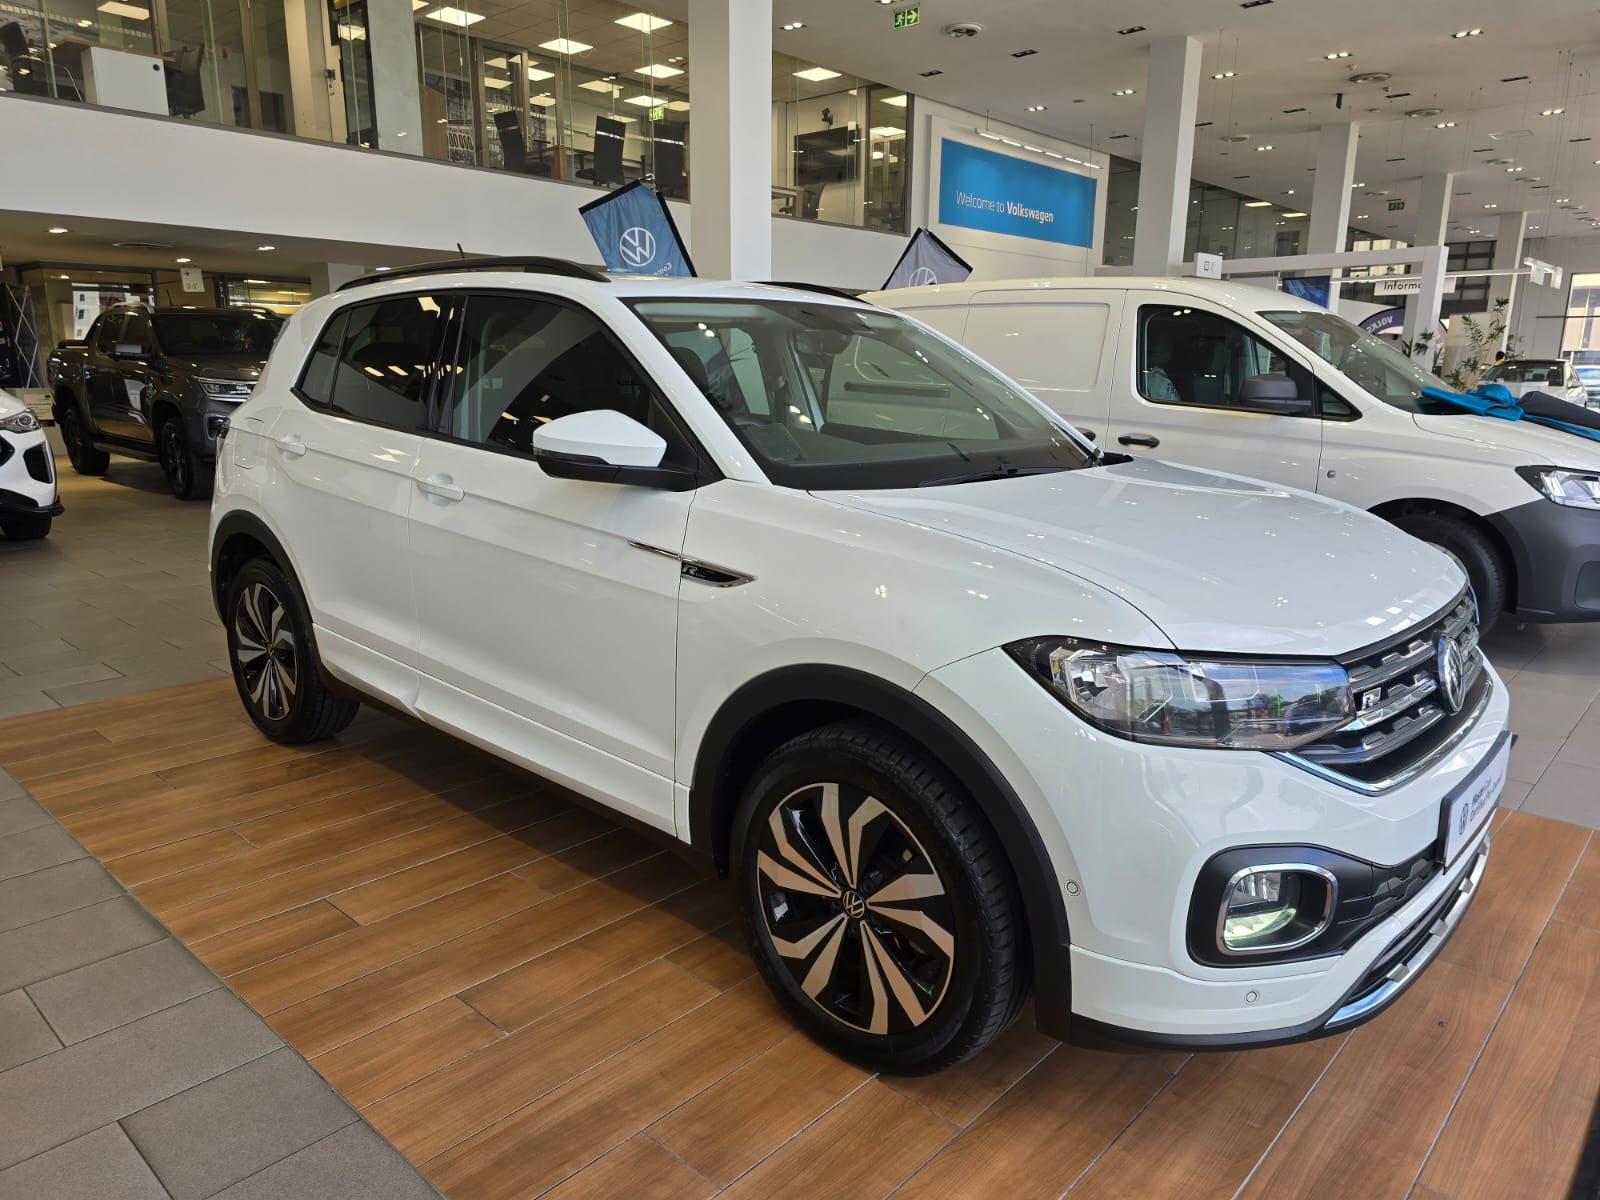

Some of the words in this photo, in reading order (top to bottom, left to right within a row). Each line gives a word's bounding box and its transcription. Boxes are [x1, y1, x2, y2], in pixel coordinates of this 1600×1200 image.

[956, 191, 996, 212] Welcome
[996, 200, 1005, 213] to
[1006, 201, 1055, 224] Volkswagen
